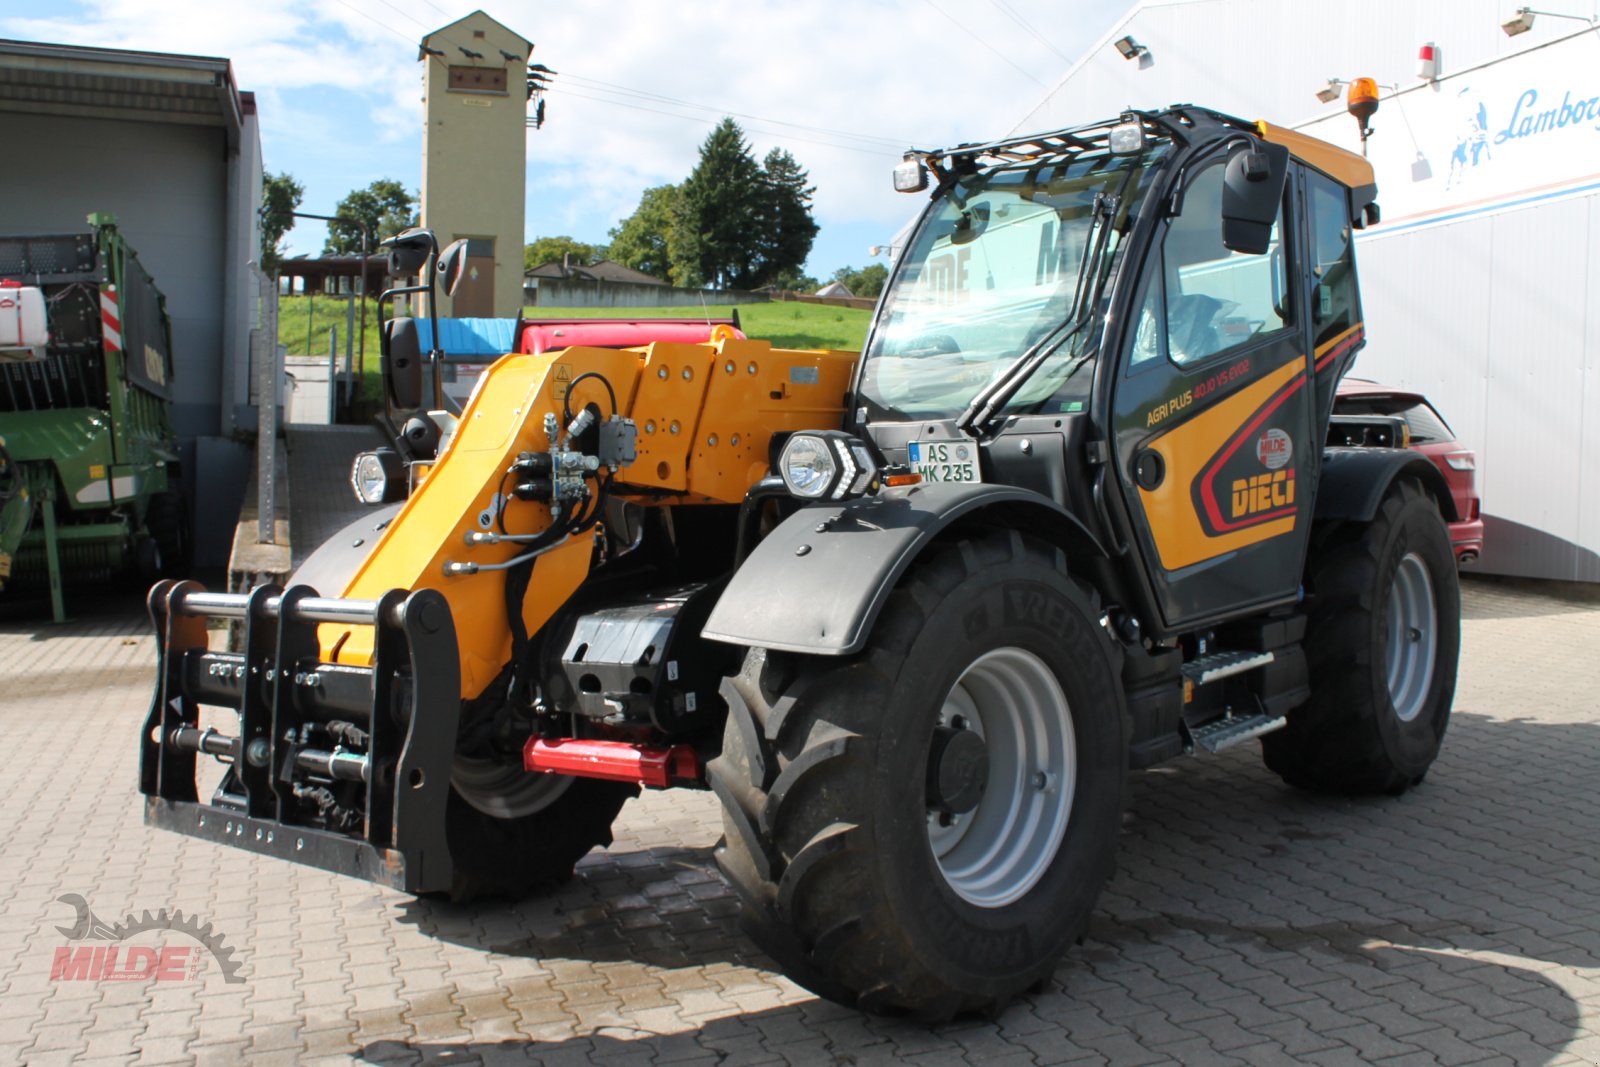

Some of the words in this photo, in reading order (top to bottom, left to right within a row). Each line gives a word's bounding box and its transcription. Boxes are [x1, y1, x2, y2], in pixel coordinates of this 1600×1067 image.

[1494, 89, 1600, 145] Lambor
[1147, 403, 1168, 427] AGRI
[1170, 390, 1193, 414] PLUS
[928, 444, 949, 462] AS
[1260, 439, 1286, 454] MILDE
[918, 464, 939, 482] MK
[942, 463, 973, 482] 235
